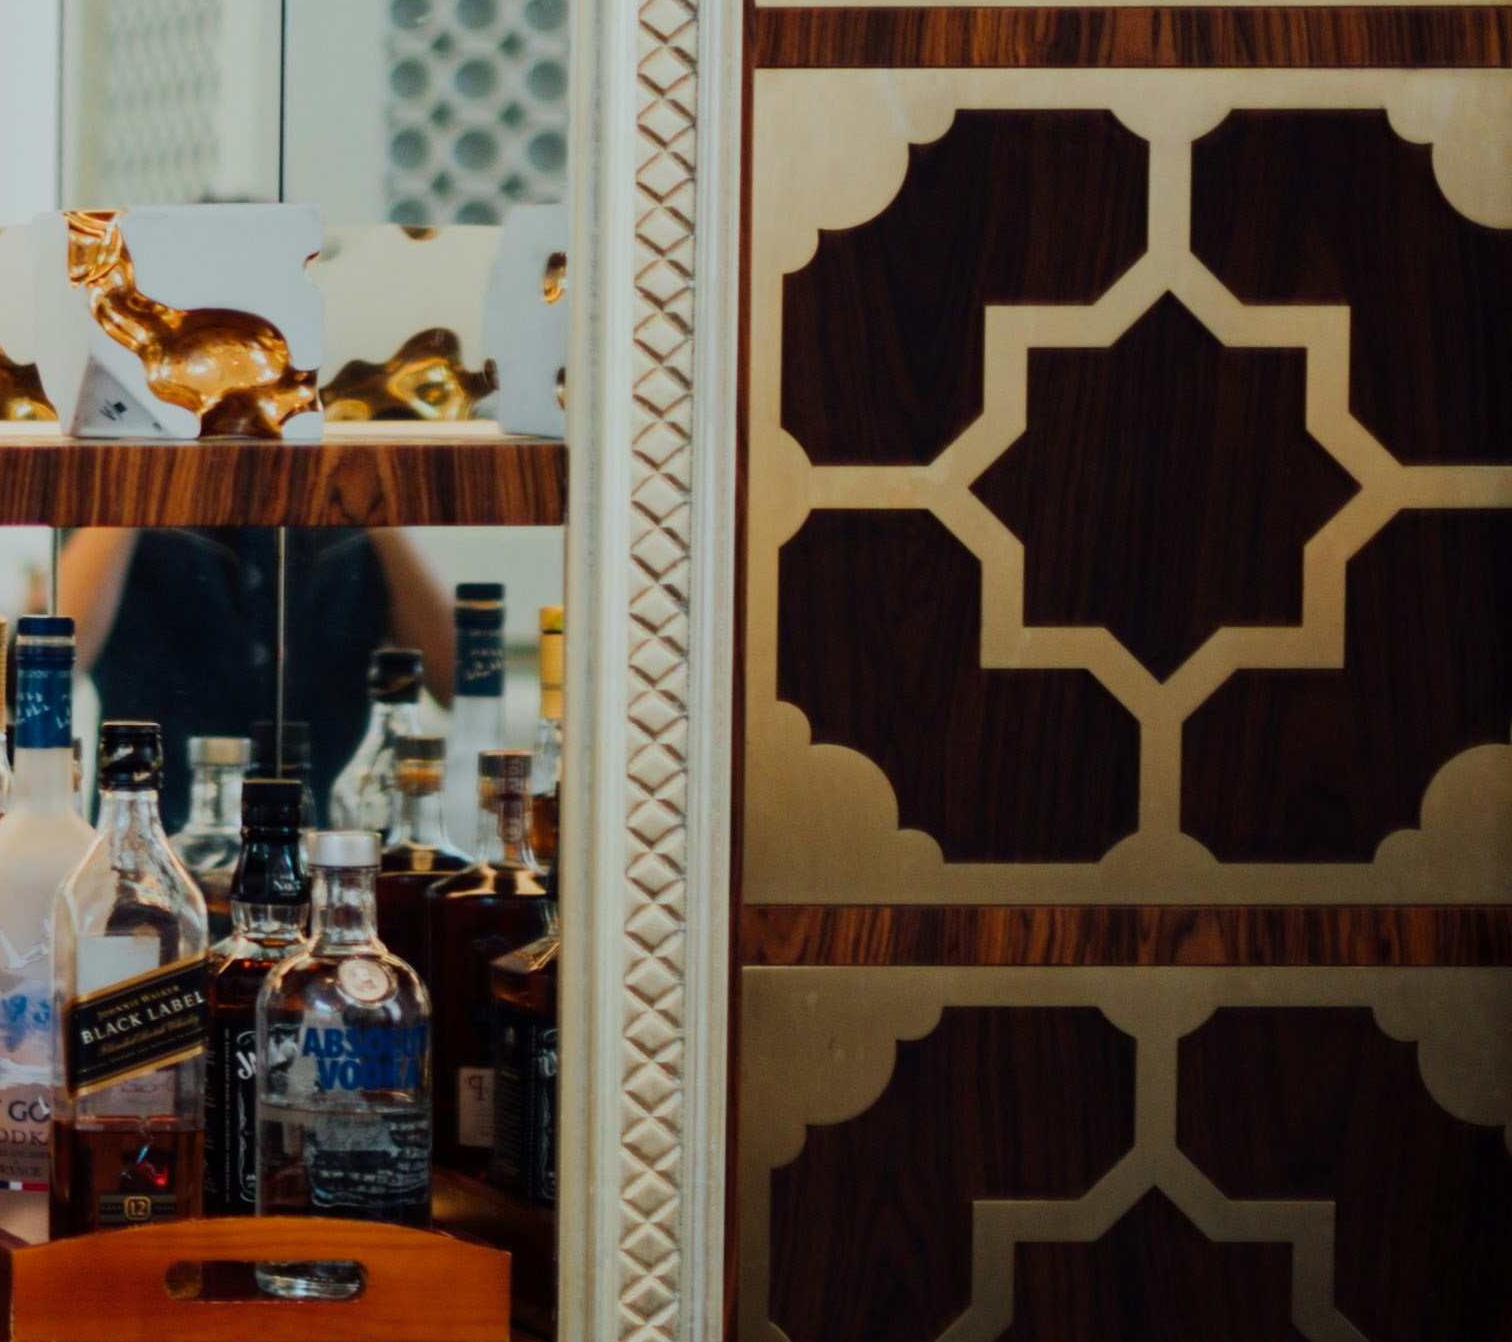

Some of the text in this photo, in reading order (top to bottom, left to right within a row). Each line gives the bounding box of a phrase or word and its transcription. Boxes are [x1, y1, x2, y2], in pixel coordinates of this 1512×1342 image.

[141, 985, 180, 1003] WALKER
[81, 991, 205, 1045] BLACK LABEL
[302, 1026, 429, 1060] ABSOLUT
[317, 1059, 420, 1091] VODKA
[129, 1201, 147, 1217] 12
